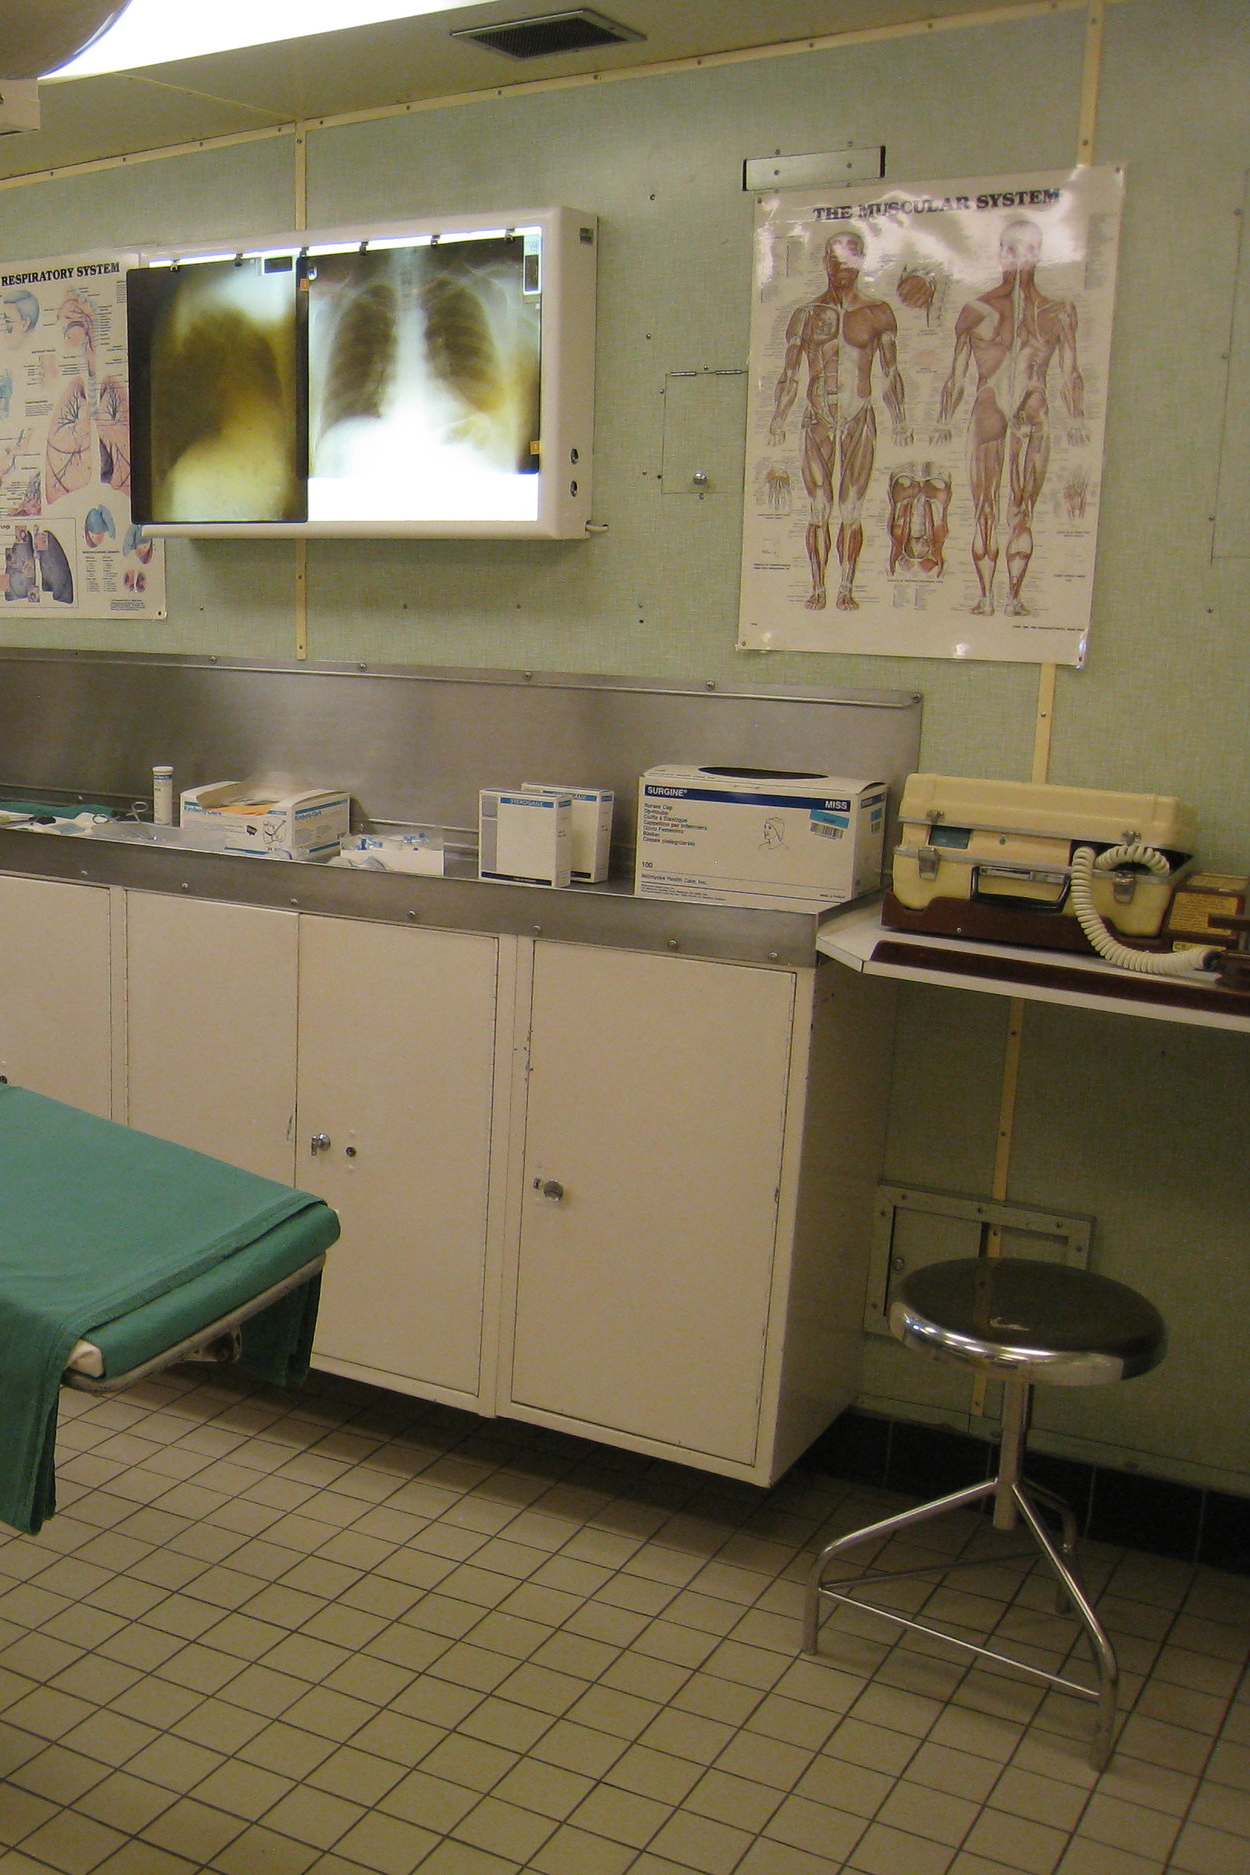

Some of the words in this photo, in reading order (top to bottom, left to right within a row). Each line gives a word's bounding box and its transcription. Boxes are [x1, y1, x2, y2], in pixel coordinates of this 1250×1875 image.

[813, 205, 852, 221] THE
[857, 196, 971, 219] MUSCULAR
[976, 188, 1062, 210] SYSTEM
[1, 267, 75, 288] RESPIRATORY
[76, 261, 120, 278] SYSTEM
[825, 800, 848, 810] MISS
[641, 861, 654, 869] 100
